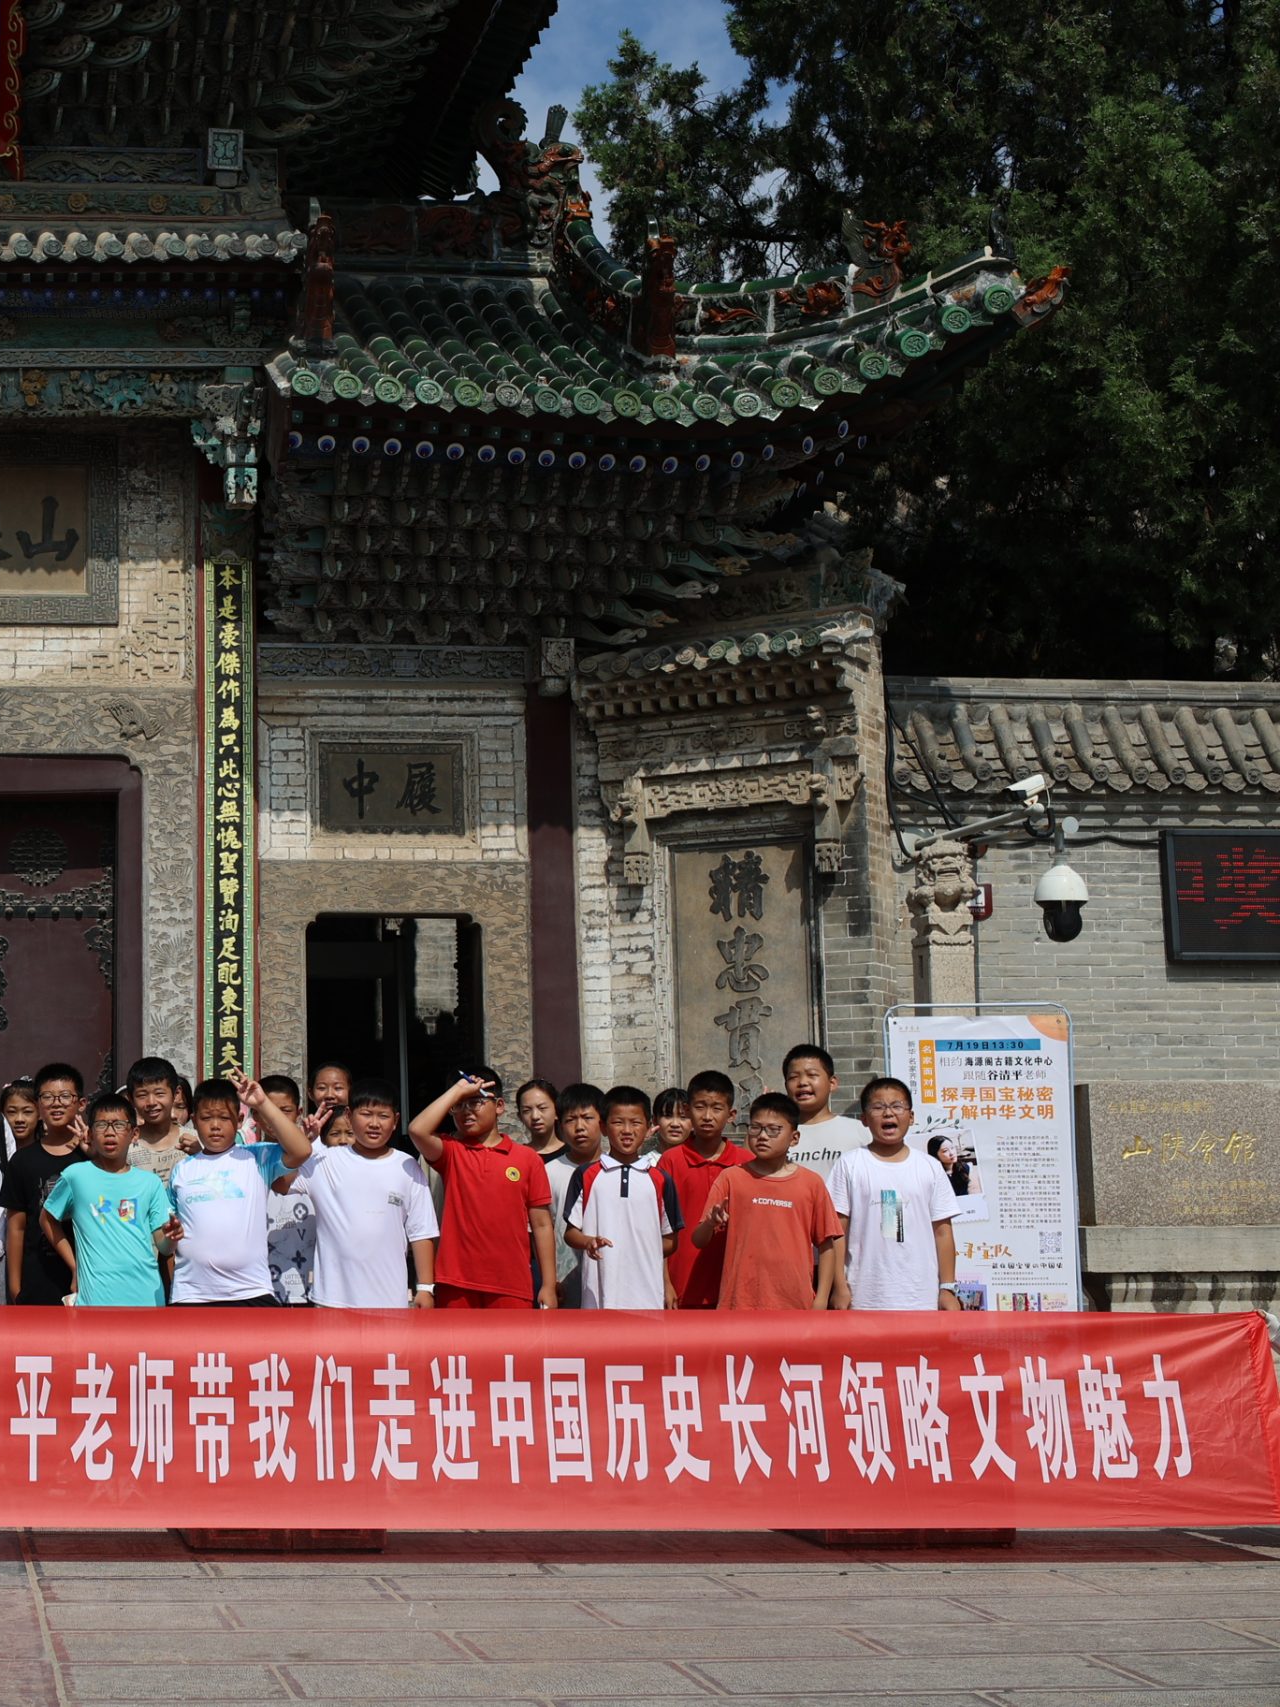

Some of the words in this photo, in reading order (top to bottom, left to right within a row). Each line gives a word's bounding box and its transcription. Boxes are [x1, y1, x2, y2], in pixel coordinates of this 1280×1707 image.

[709, 850, 773, 1089] 精忠貫
[947, 1041, 1024, 1050] 7月19日13:30
[941, 1086, 1054, 1102] 探寻国宝秘密
[943, 1104, 1055, 1120] 了解中华文明
[758, 1198, 793, 1208] CONVERSE
[955, 1242, 1012, 1260] 寻宝队
